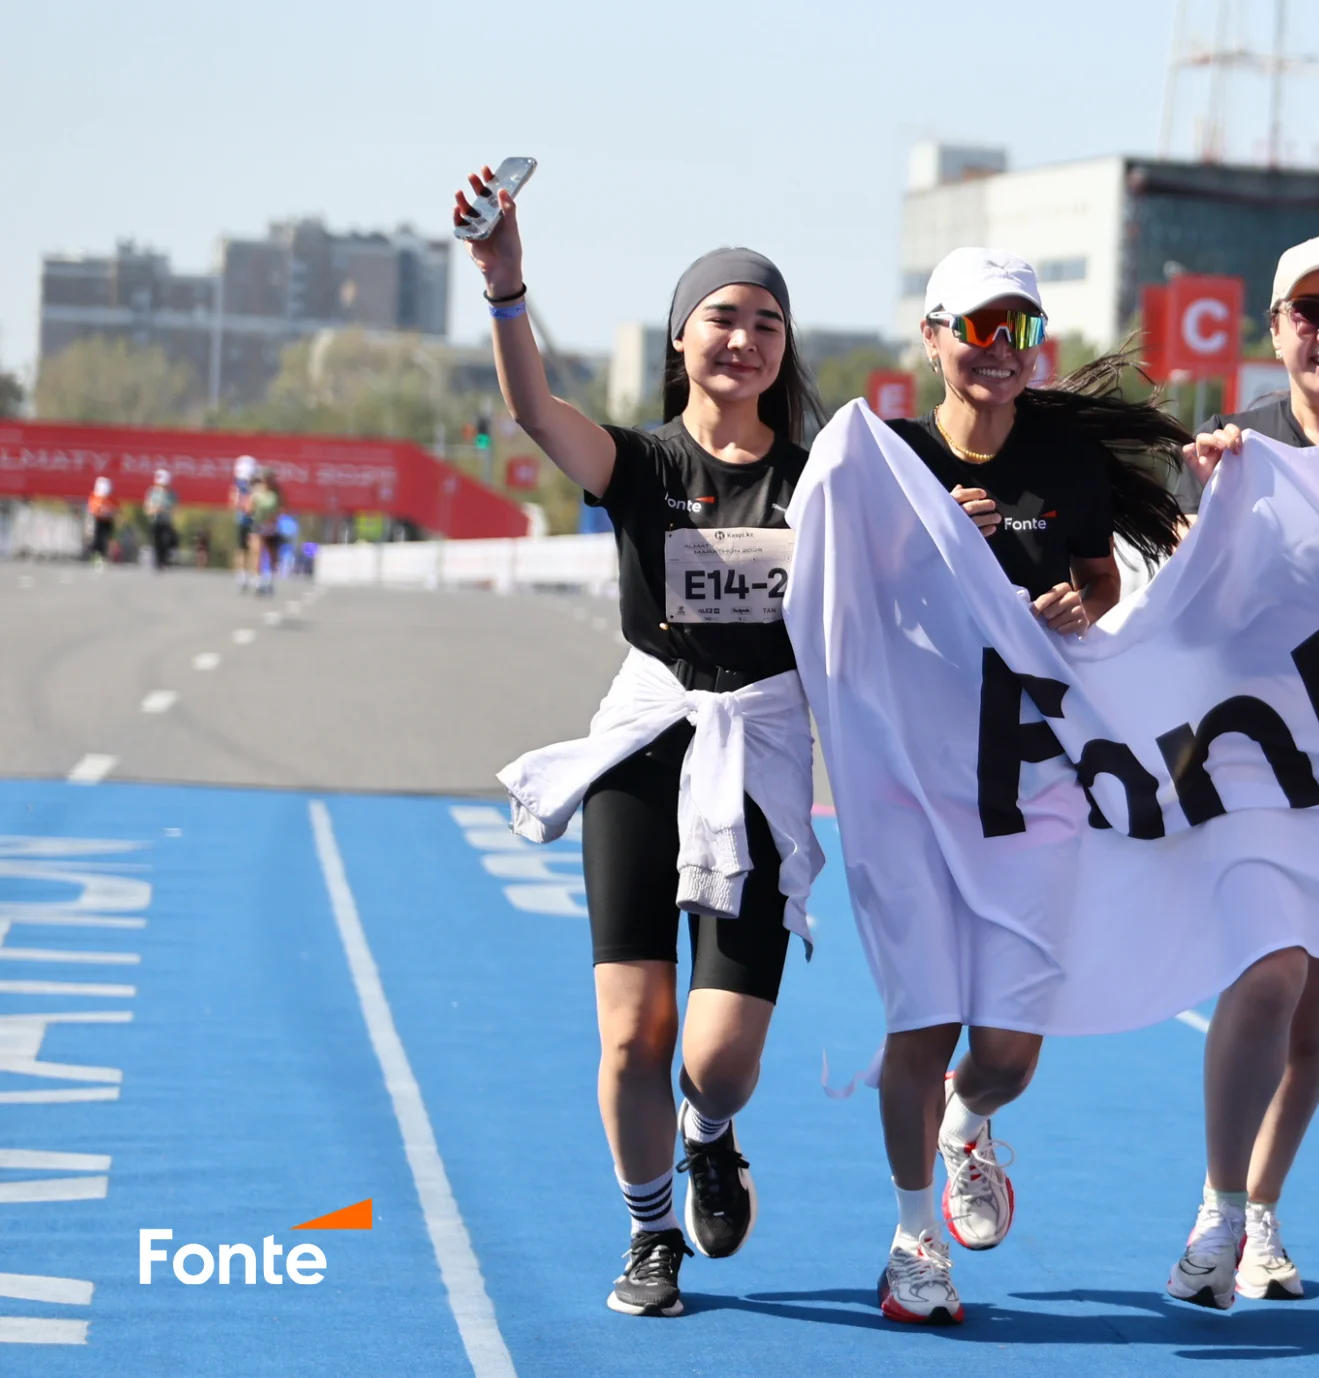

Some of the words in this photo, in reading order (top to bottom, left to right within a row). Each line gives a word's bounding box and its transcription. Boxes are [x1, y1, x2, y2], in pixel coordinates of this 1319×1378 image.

[1182, 298, 1229, 355] C
[121, 452, 309, 483] MARATON
[1004, 516, 1047, 531] Fonte
[684, 567, 788, 600] E14-2
